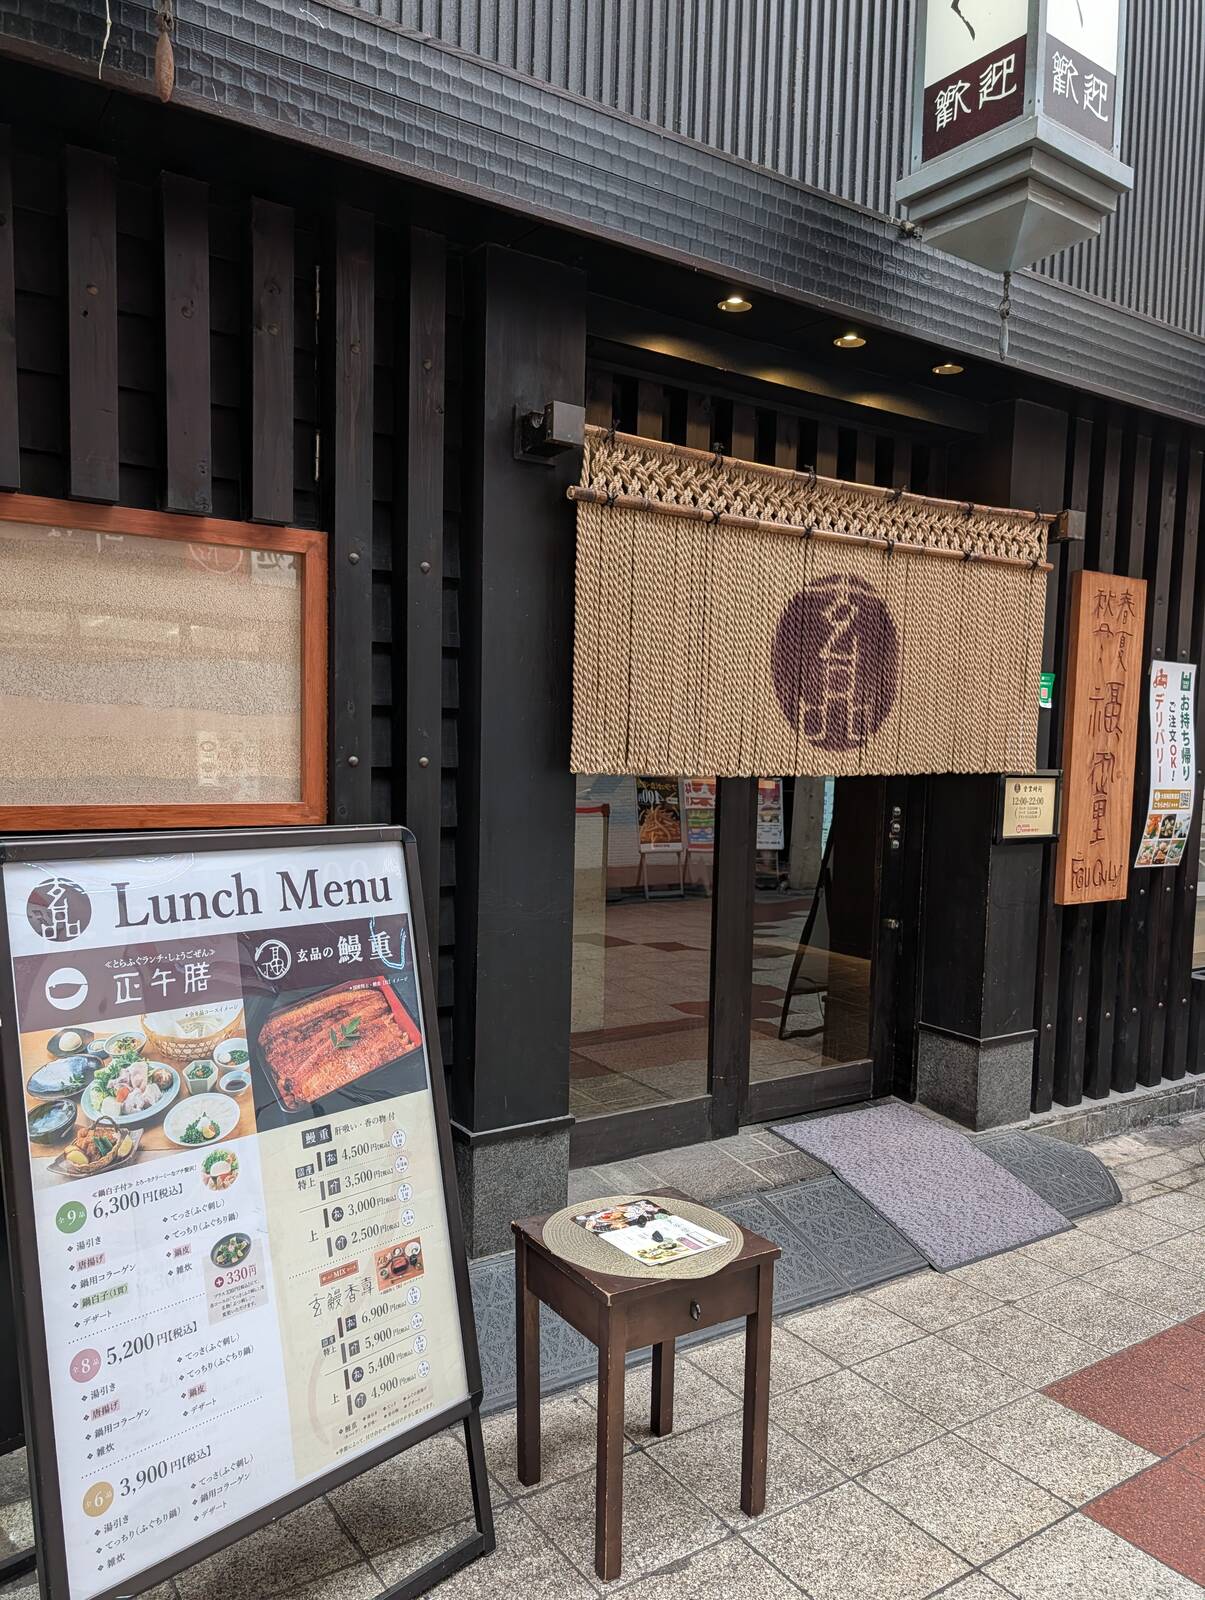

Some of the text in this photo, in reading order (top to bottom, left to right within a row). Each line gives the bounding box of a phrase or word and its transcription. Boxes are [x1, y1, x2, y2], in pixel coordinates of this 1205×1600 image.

[1154, 693, 1165, 783] デリバリー
[1168, 701, 1177, 782] ご注文OK!
[1180, 695, 1191, 782] お持ち帰り
[111, 868, 393, 929] Lunch Menu
[113, 962, 212, 1004] 正午膳
[305, 1127, 329, 1145] 鰻重
[297, 1177, 316, 1191] 特上
[76, 1235, 102, 1252] 湯引き
[308, 1229, 319, 1243] 上
[77, 1254, 105, 1270] 唐揚げ
[175, 1263, 193, 1276] 雑炊
[226, 1264, 257, 1285] 330円
[83, 1309, 112, 1327] デザート
[91, 1382, 117, 1400] 湯引き
[330, 1393, 340, 1405] 上
[92, 1400, 119, 1419] 唐揚げ
[191, 1397, 217, 1415] デザート
[201, 1500, 229, 1518] デザート
[103, 1514, 129, 1534] 湯引き
